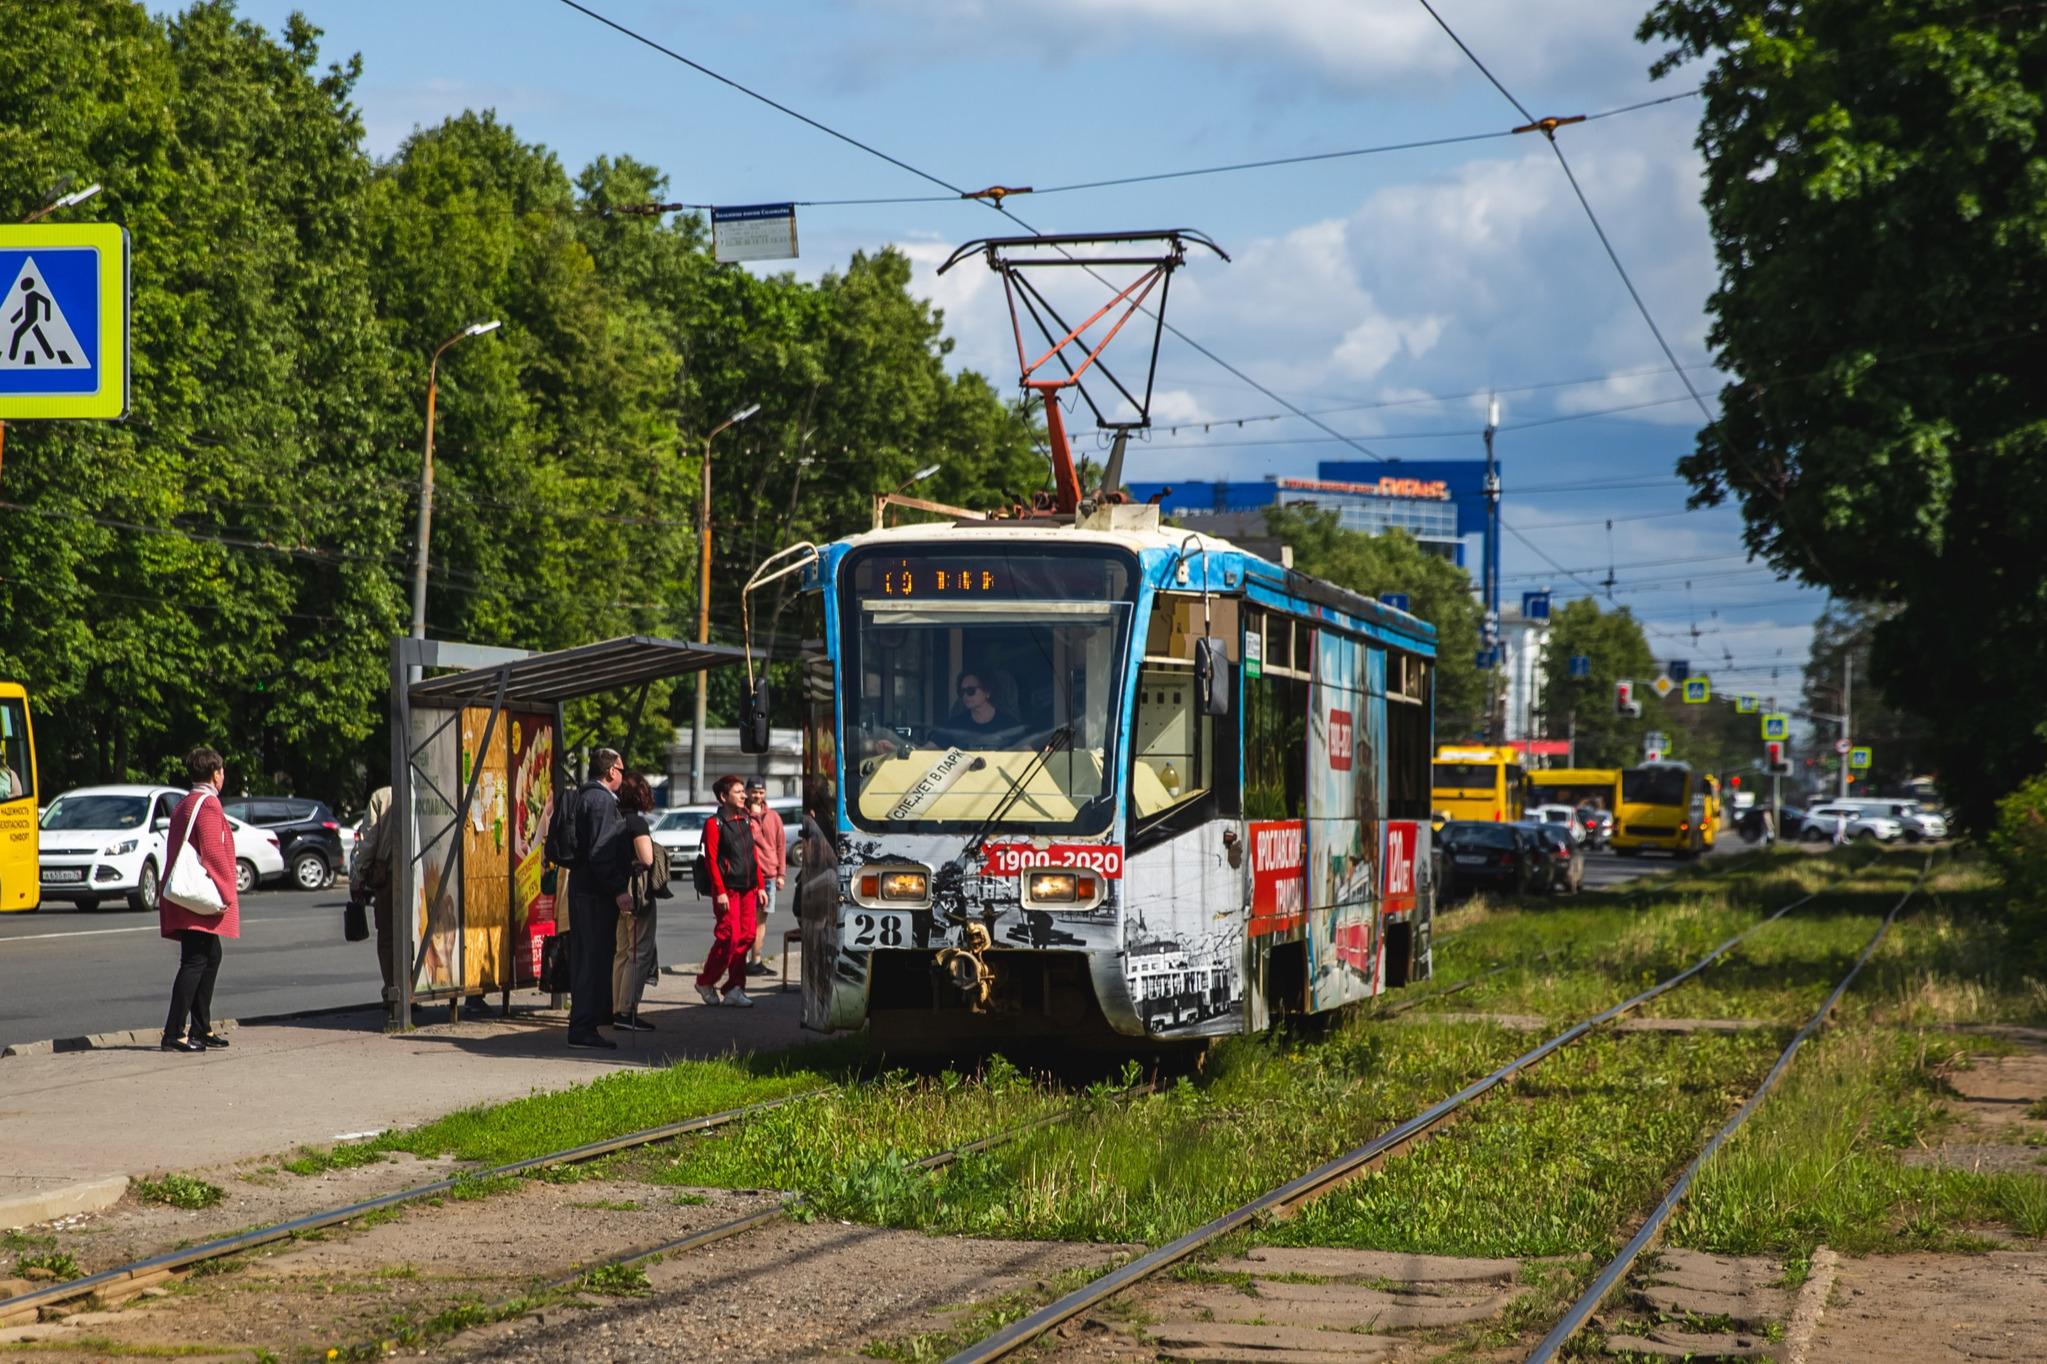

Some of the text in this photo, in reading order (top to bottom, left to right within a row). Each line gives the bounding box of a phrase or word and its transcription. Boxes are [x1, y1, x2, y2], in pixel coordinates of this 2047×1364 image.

[893, 749, 965, 819] СЛЕДУЕТ В ПАРК
[854, 914, 903, 946] 28
